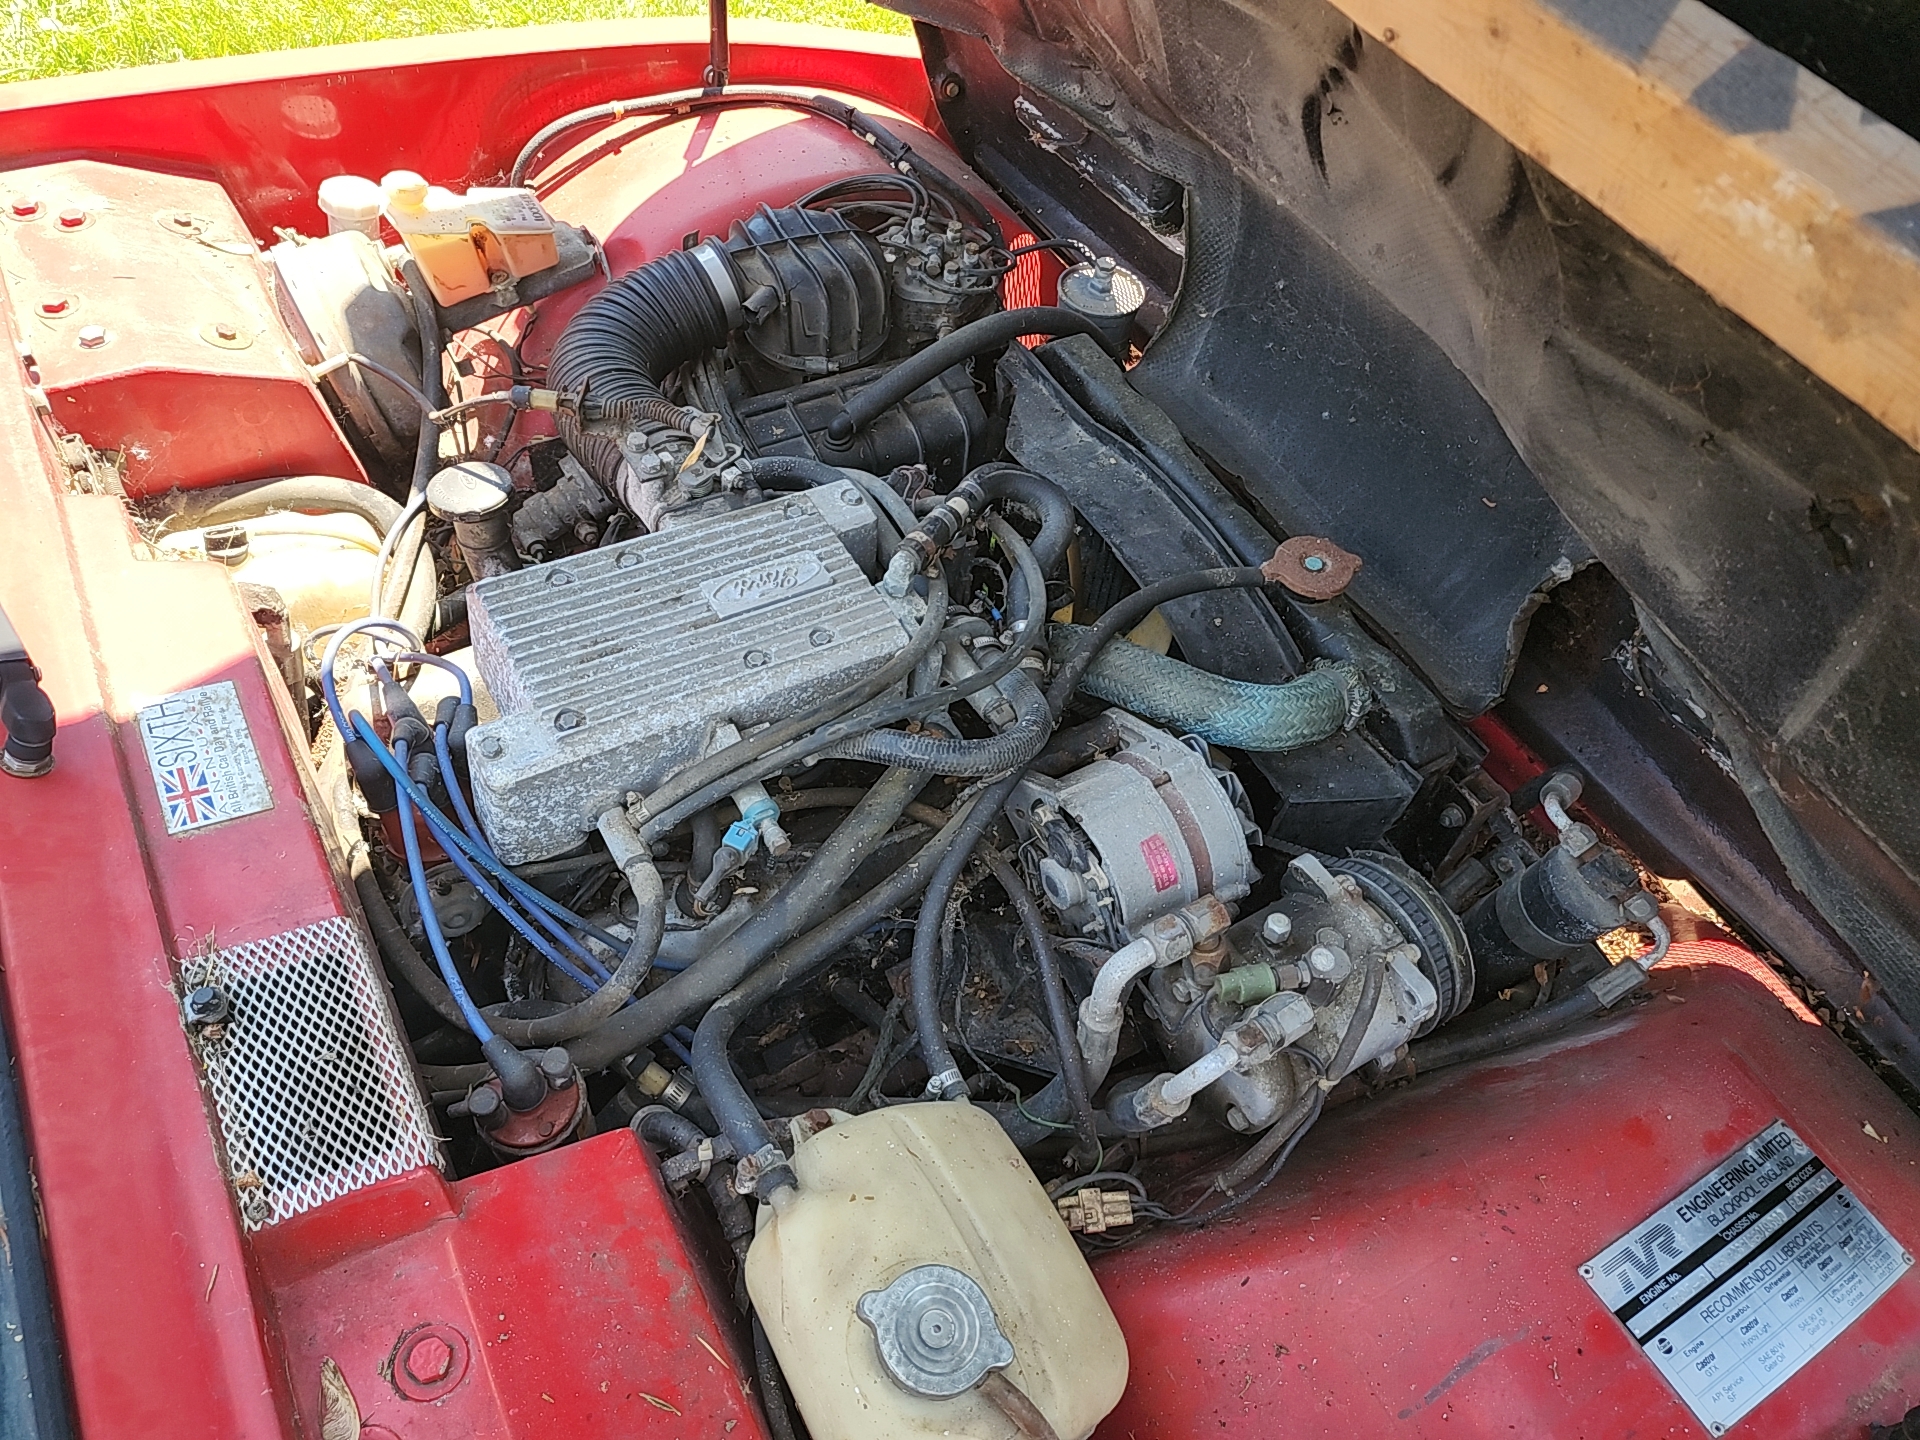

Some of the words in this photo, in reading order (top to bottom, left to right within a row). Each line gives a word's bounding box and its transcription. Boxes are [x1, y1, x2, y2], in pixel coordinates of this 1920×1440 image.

[199, 691, 213, 718] Rallye
[142, 699, 198, 768] SIXTH
[208, 717, 220, 735] and
[213, 734, 225, 753] Day
[218, 753, 230, 770] Car
[223, 769, 239, 799] British
[231, 800, 244, 814] All
[423, 806, 450, 833] PREMIUM
[1674, 1157, 1758, 1224] ENGINEERING
[1748, 1129, 1794, 1167] LIMITED
[1783, 1174, 1803, 1192] BODY
[1705, 1181, 1762, 1227] BLACKPOOL
[1754, 1153, 1797, 1189] ENGLAND
[1720, 1215, 1752, 1242] CHASSIS
[1745, 1207, 1761, 1222] No.
[1599, 1221, 1683, 1295] TVR
[1815, 1253, 1835, 1272] Castrol
[1698, 1256, 1778, 1325] RECOMMENDED
[1770, 1218, 1825, 1266] LUBRICANTS
[1762, 1267, 1792, 1294] Differential
[1637, 1277, 1670, 1305] ENGINE
[1664, 1267, 1682, 1285] No.
[1778, 1282, 1800, 1303] Castrol
[1725, 1301, 1751, 1325] Gearbox
[1738, 1315, 1761, 1336] Castrol
[1755, 1320, 1772, 1337] Light
[1682, 1337, 1706, 1359] Engine
[1693, 1350, 1717, 1372] Castrol
[1703, 1362, 1720, 1378] GTX
[1762, 1357, 1779, 1374] Gear
[1710, 1389, 1725, 1404] API
[1721, 1373, 1745, 1396] Service
[1726, 1390, 1739, 1403] SF
